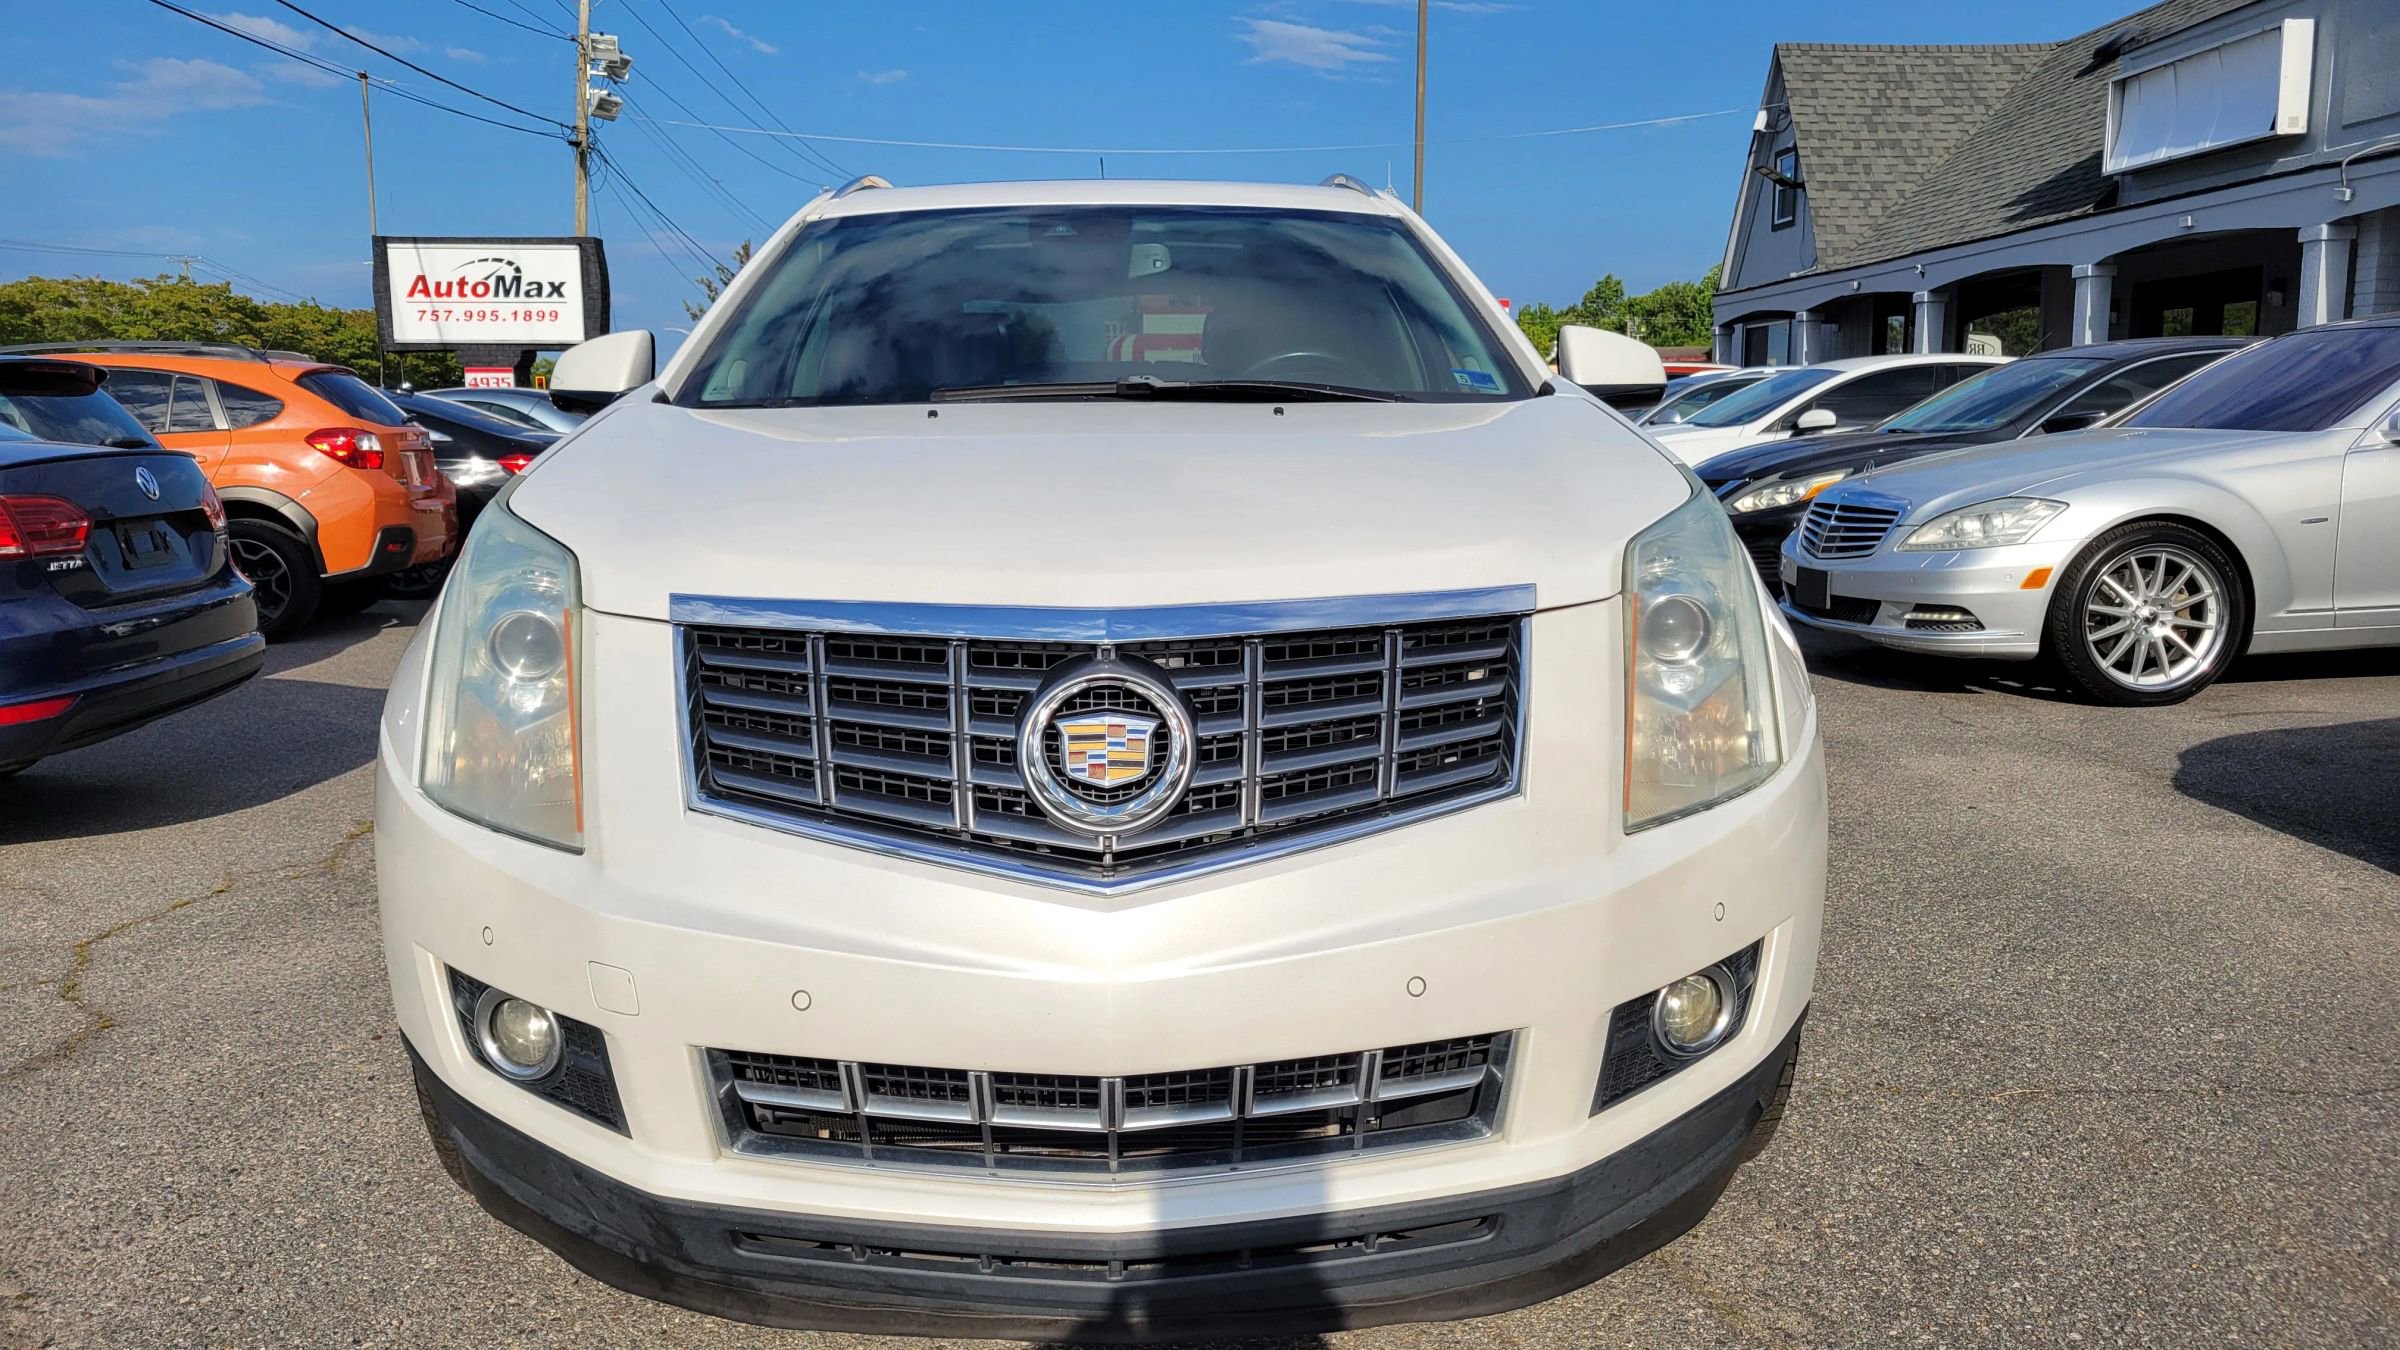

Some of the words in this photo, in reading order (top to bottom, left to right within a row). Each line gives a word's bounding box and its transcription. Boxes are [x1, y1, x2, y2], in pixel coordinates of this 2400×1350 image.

[406, 274, 567, 298] AutoMax
[417, 310, 559, 322] 757.995.1899
[46, 559, 83, 571] JETTA
